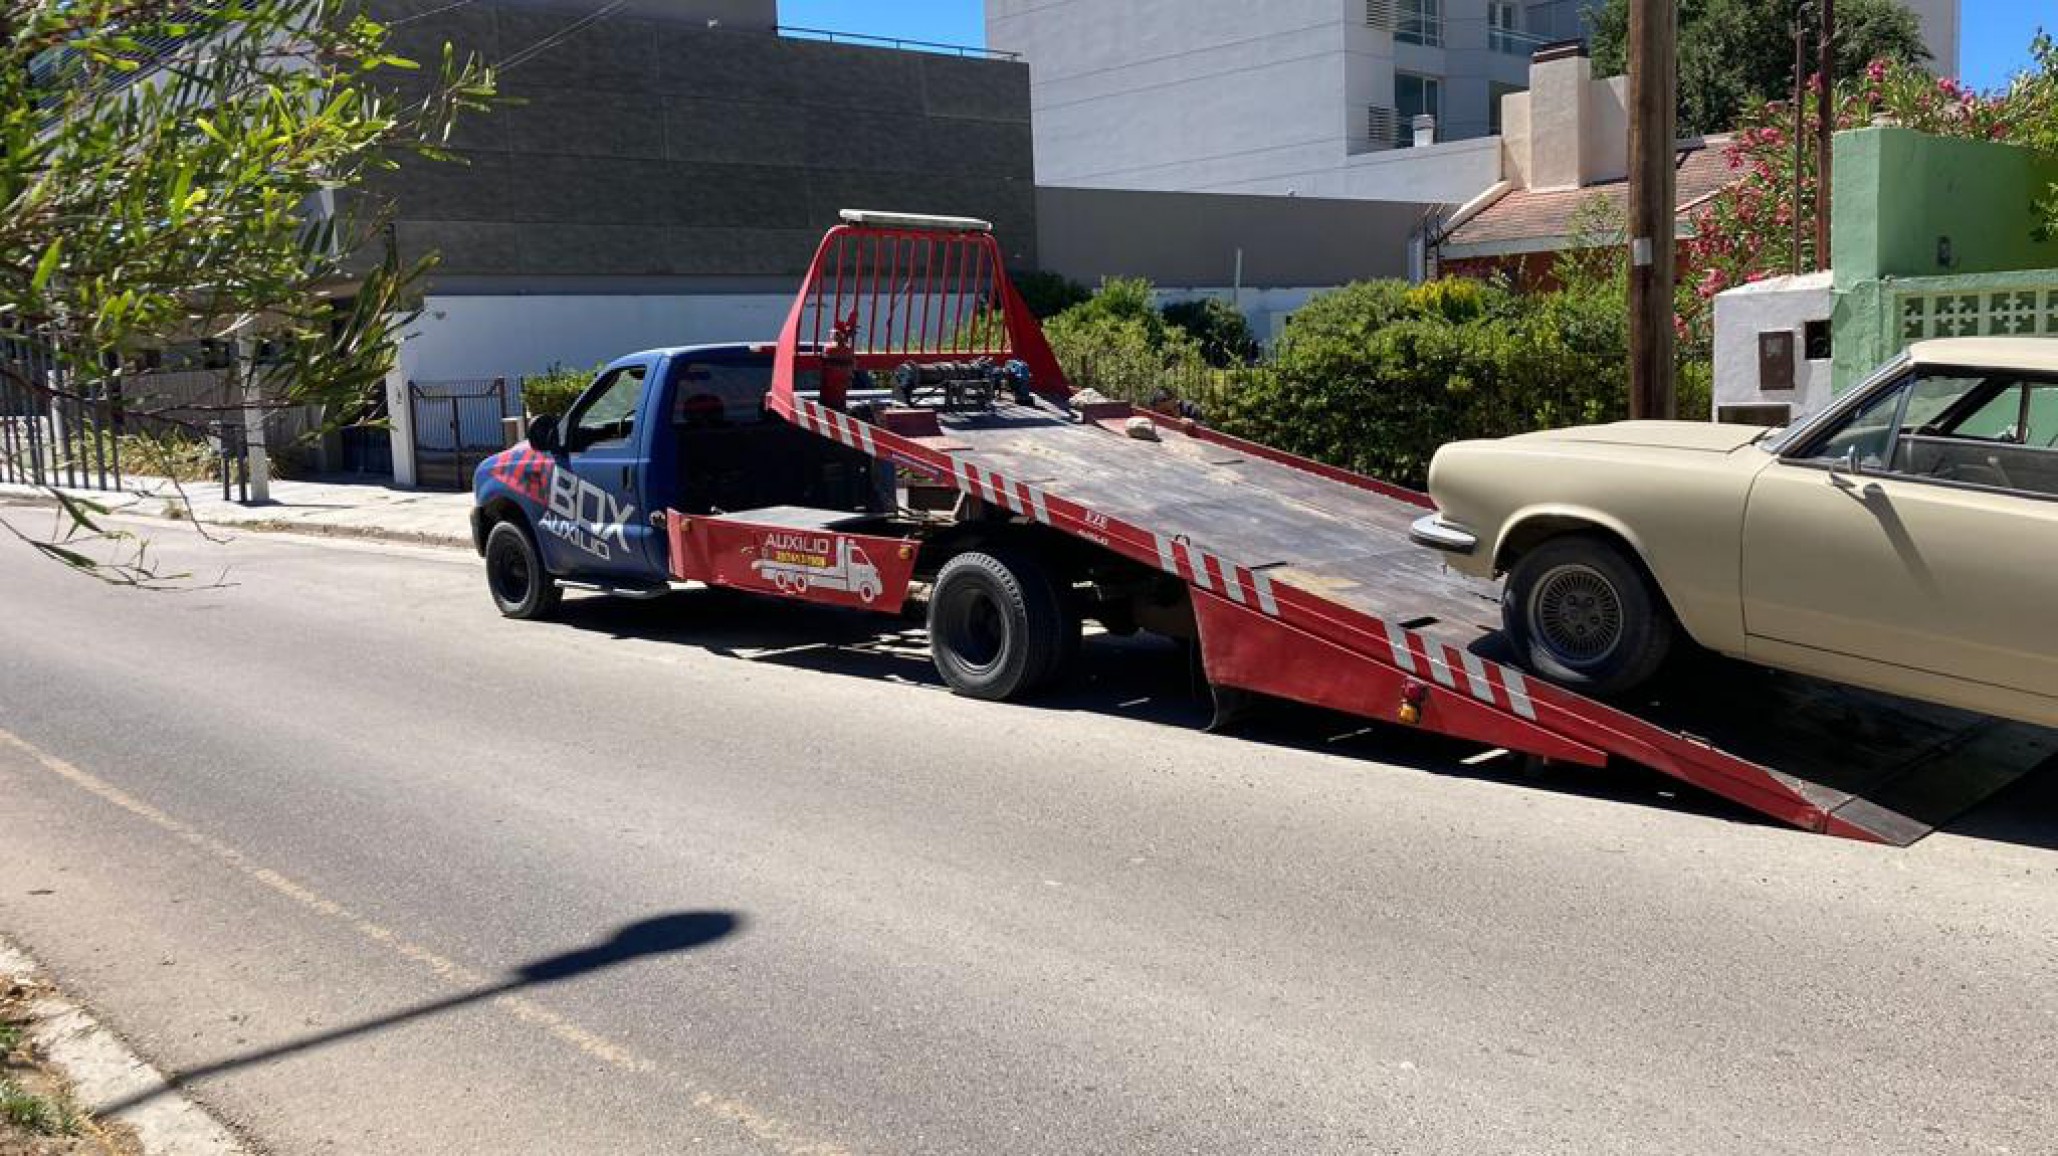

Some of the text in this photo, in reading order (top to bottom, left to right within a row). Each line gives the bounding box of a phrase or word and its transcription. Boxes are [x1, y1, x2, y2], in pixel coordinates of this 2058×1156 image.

[549, 466, 634, 552] BOX
[538, 512, 610, 560] AUXILIO
[765, 532, 829, 554] AUXILIO
